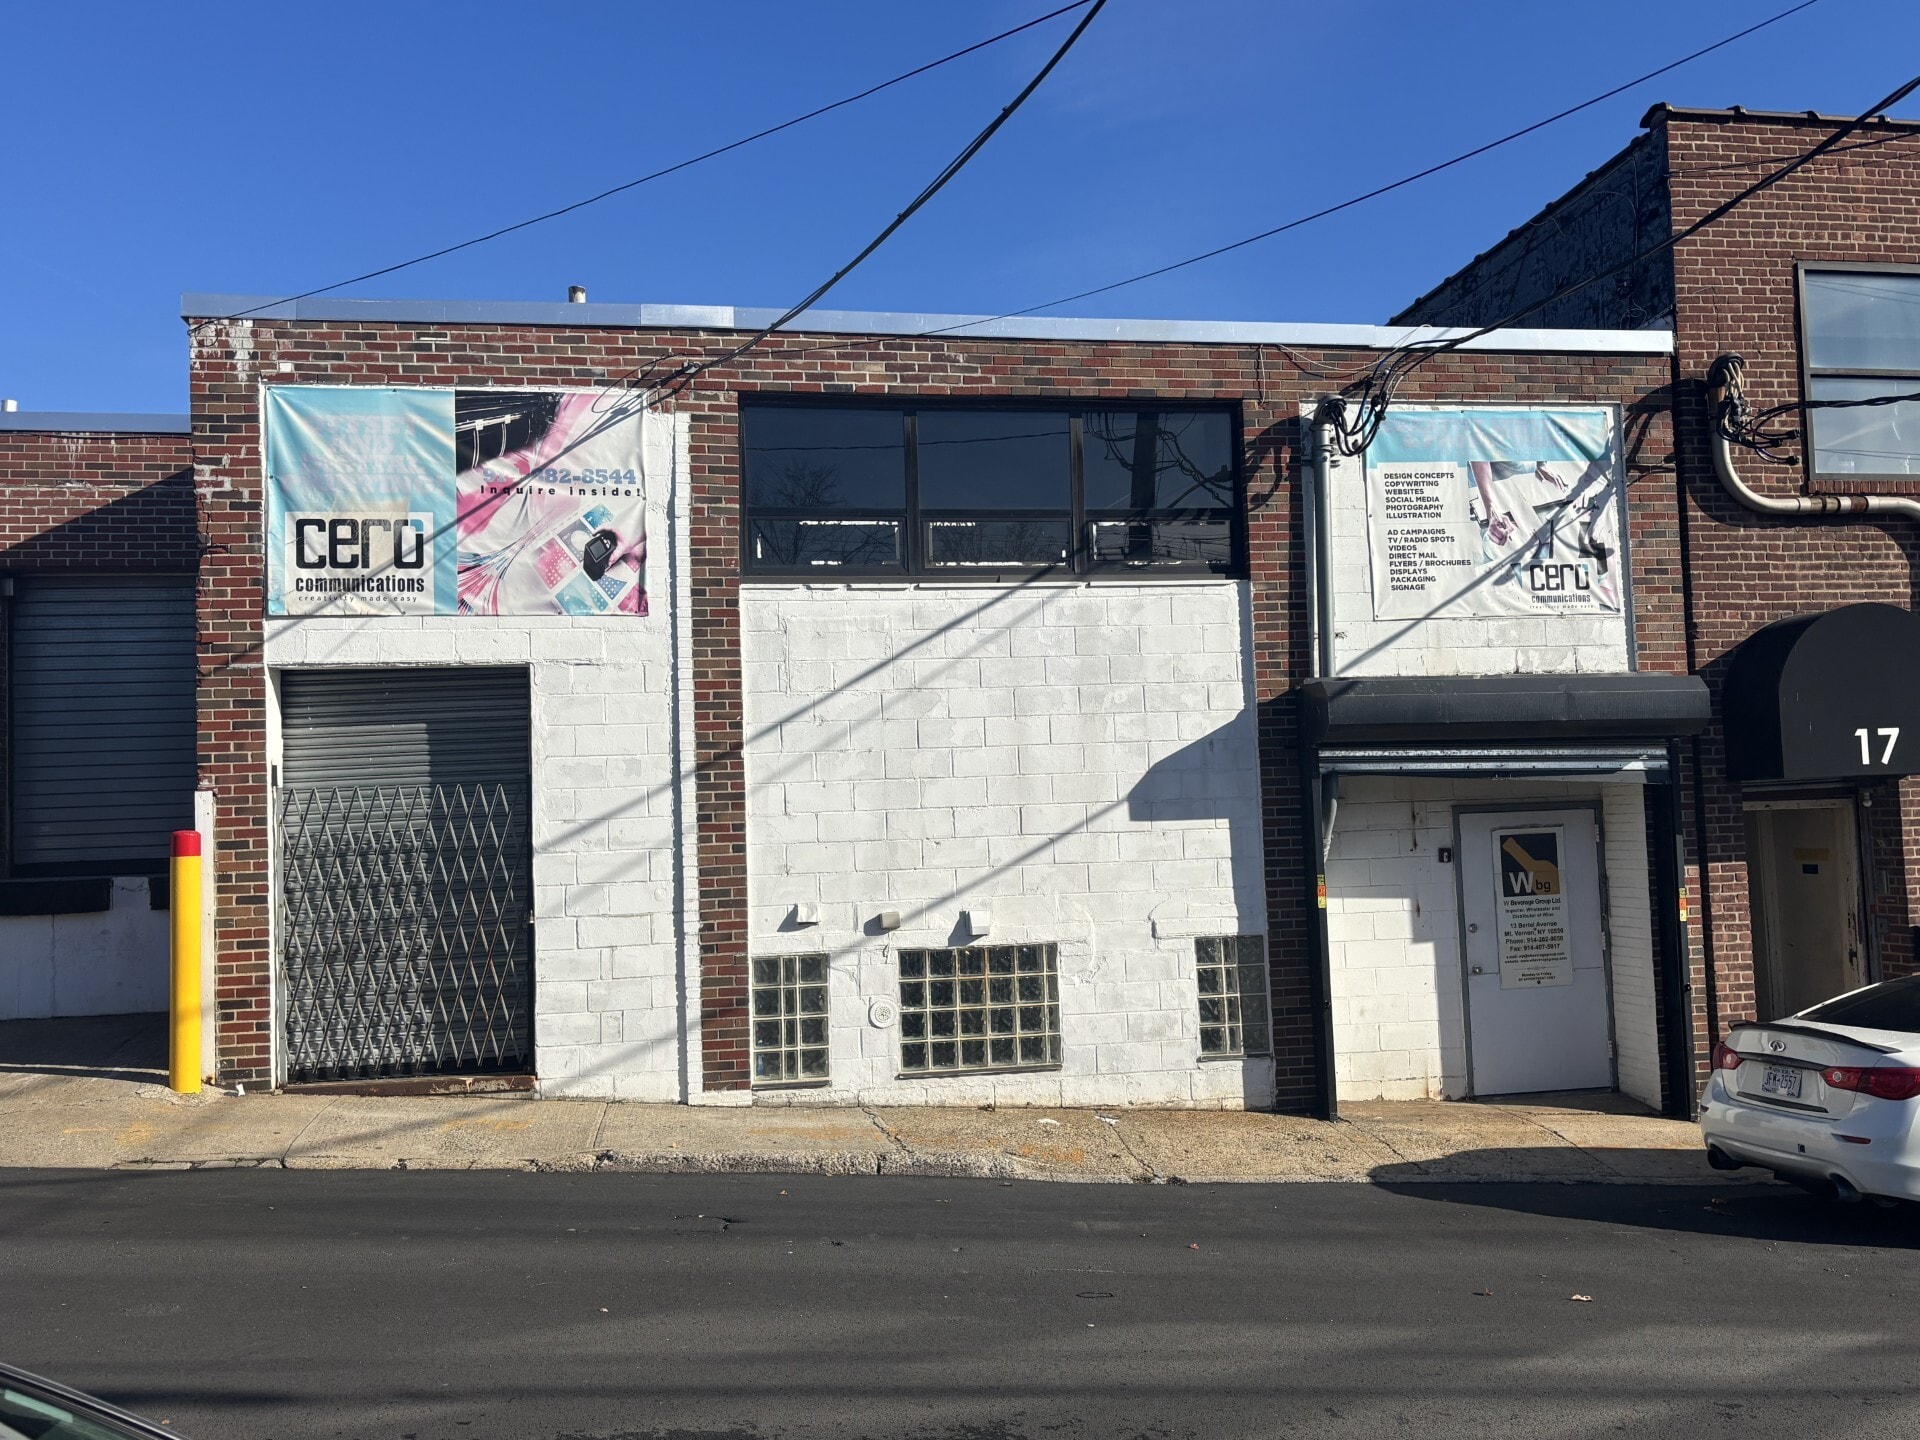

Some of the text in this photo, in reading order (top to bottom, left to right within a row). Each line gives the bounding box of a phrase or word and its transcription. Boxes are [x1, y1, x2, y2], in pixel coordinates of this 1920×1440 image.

[481, 485, 641, 496] Inquire inside!
[295, 518, 424, 569] cero
[295, 575, 425, 592] communications
[1530, 564, 1591, 591] cero
[1531, 593, 1591, 604] communications
[1854, 727, 1900, 765] 17
